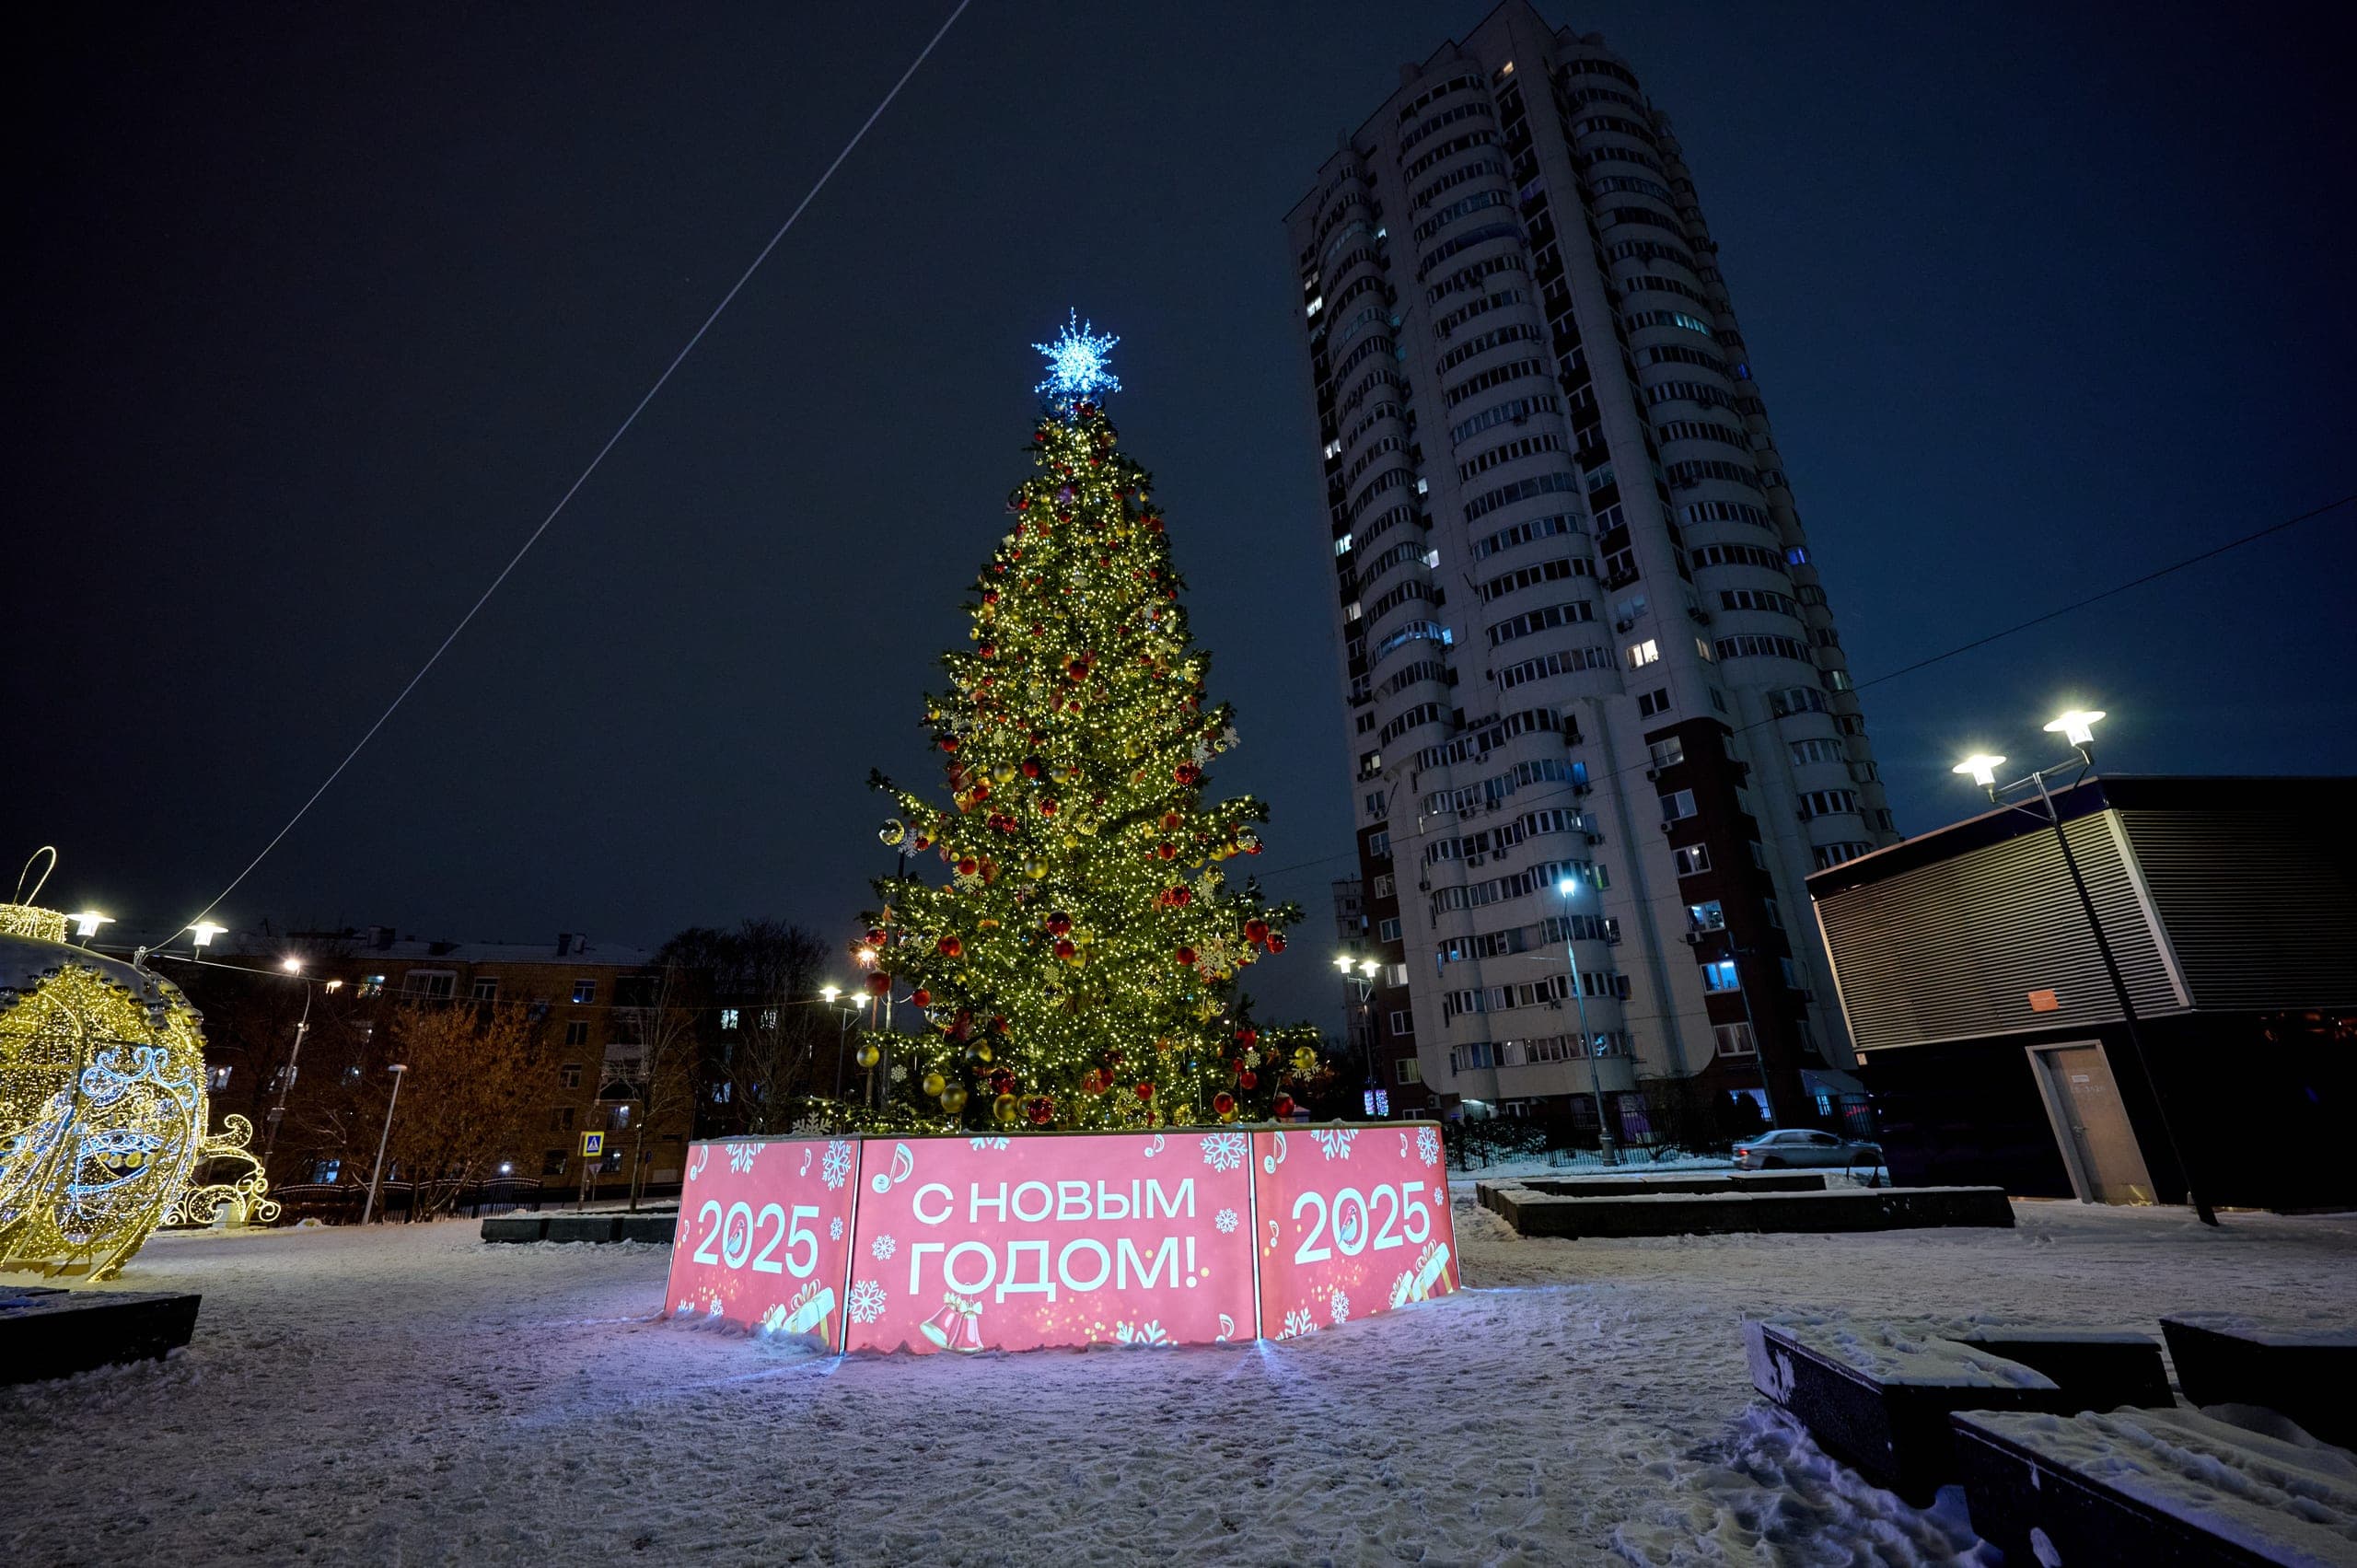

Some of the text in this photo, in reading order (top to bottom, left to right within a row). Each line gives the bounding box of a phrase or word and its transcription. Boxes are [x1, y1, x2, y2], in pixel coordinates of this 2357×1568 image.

[912, 1178, 1196, 1225] С НОВЫМ
[1292, 1180, 1431, 1265] 2025
[692, 1200, 819, 1278] 2025
[909, 1237, 1196, 1304] ГОДОМ!
